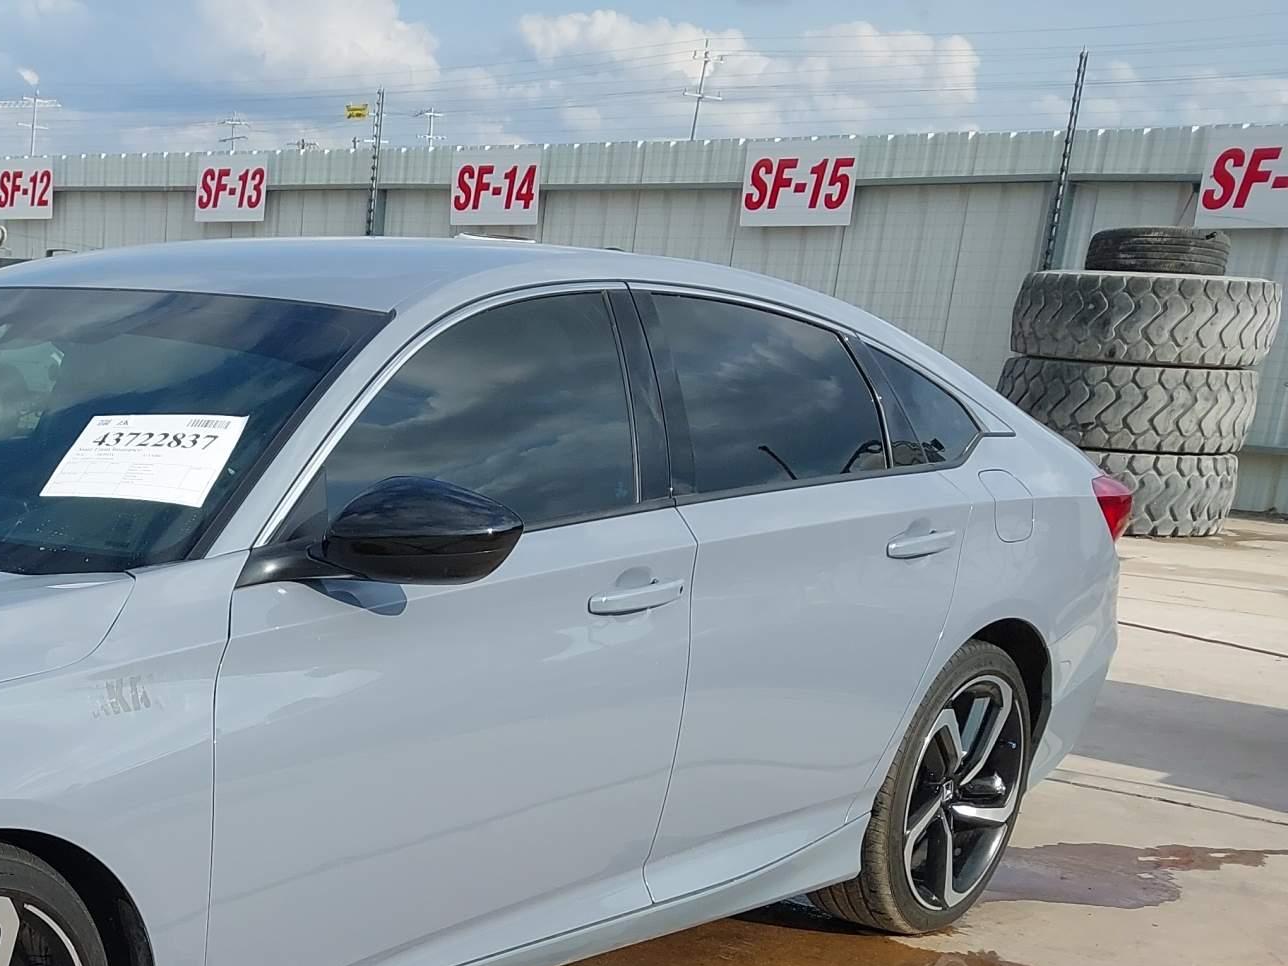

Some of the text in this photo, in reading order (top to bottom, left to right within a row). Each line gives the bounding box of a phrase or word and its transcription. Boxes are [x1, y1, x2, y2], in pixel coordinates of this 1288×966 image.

[197, 167, 265, 210] SF-13
[453, 164, 537, 211] SF-14
[743, 157, 855, 210] SF-15
[92, 431, 220, 450] 43722837
